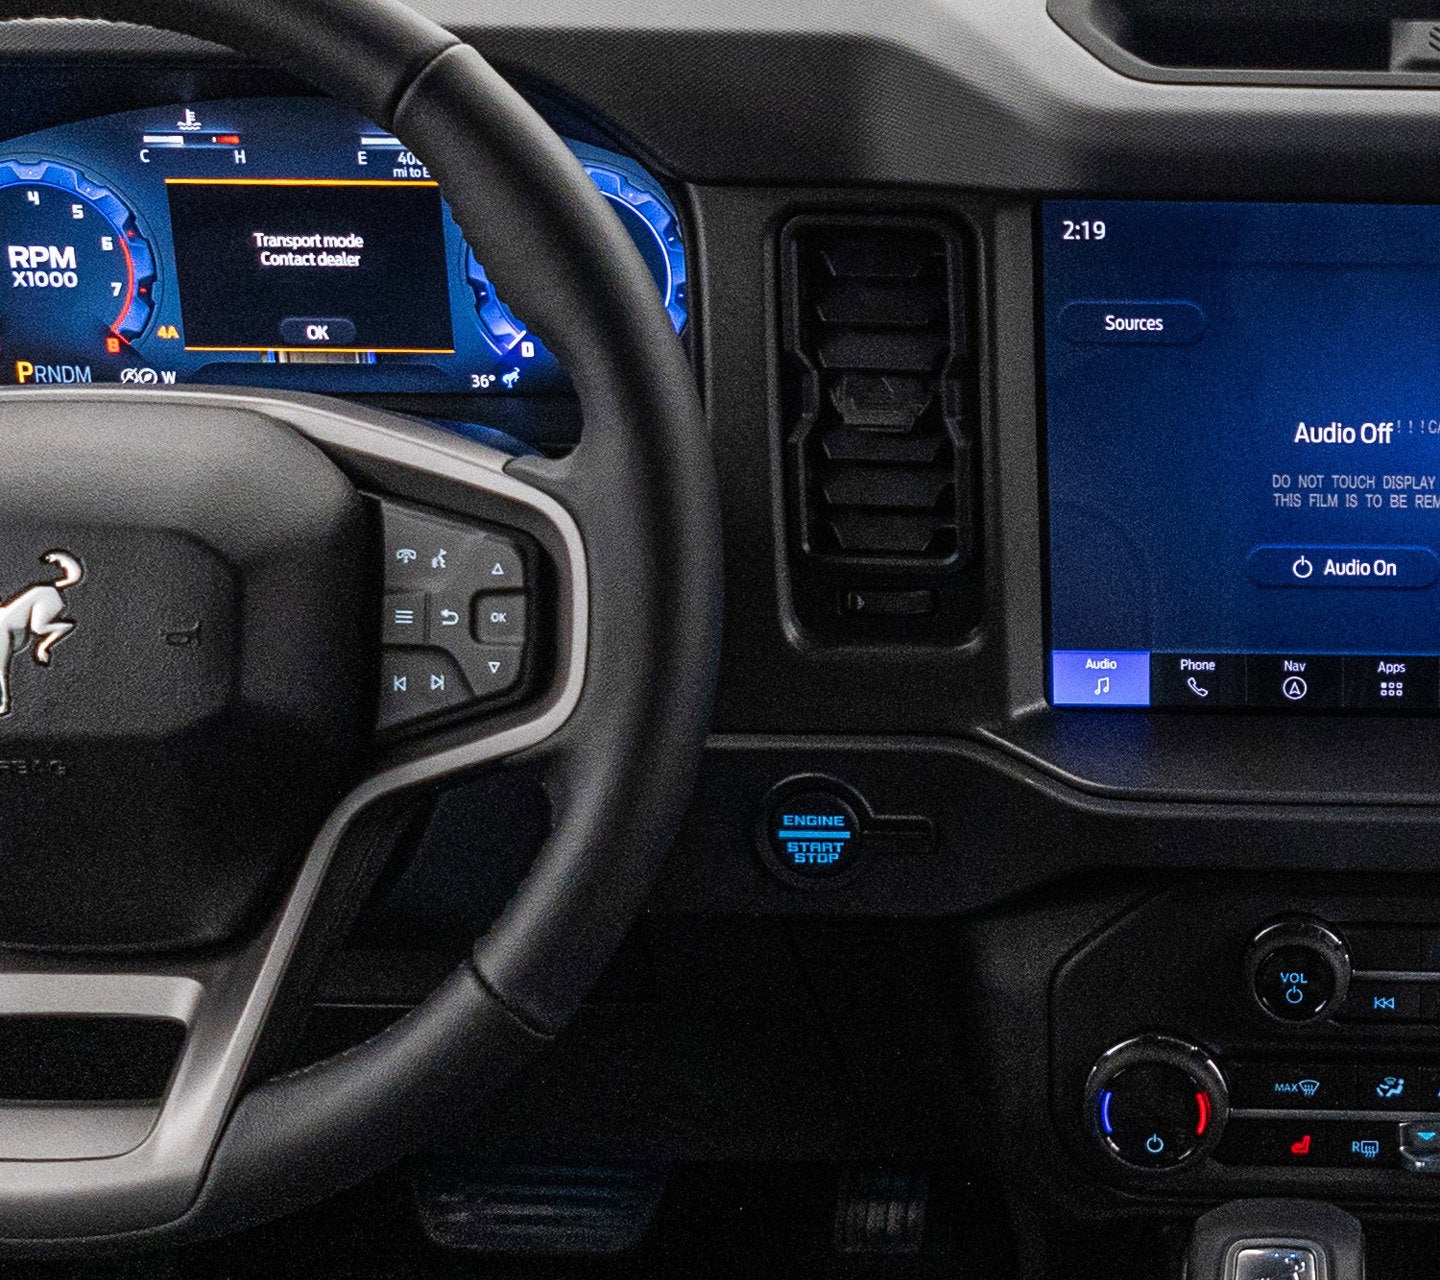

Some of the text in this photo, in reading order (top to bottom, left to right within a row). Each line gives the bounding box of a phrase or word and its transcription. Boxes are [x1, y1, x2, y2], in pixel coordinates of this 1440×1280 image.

[140, 150, 150, 163] C
[234, 150, 246, 163] H
[357, 151, 367, 165] E
[393, 167, 408, 178] mi
[410, 168, 421, 178] to
[28, 191, 39, 205] 4
[72, 205, 84, 219] 5
[1062, 221, 1107, 242] 2:19
[102, 237, 113, 251] 6
[253, 232, 364, 249] Transport mode
[8, 246, 76, 269] RPM
[261, 252, 361, 267] Contact dealer
[13, 272, 78, 287] X1000
[111, 283, 122, 296] 7
[1105, 314, 1164, 333] Sources
[157, 326, 179, 339] 4A
[307, 326, 329, 340] OK
[106, 337, 120, 353] 8
[161, 371, 176, 383] W
[1294, 422, 1393, 443] Audio Off
[1272, 475, 1291, 488] DO
[1298, 475, 1324, 488] NOT
[1332, 475, 1375, 489] TOUCH
[1383, 476, 1436, 490] DISPLAY
[1273, 494, 1302, 508] THIS
[1310, 494, 1338, 508] FILM
[1346, 494, 1357, 508] IS
[1365, 495, 1382, 508] TO
[1390, 495, 1408, 508] BE
[1324, 559, 1397, 576] Audio On
[491, 612, 506, 622] OK
[1085, 657, 1118, 671] Audio
[1179, 658, 1216, 671] Phone
[1283, 660, 1306, 672] Nav
[1377, 661, 1406, 676] Apps
[783, 815, 845, 826] ENGINE
[787, 842, 844, 853] START
[795, 853, 839, 864] STOP
[1280, 972, 1308, 985] VOL
[1274, 1082, 1299, 1093] MAX
